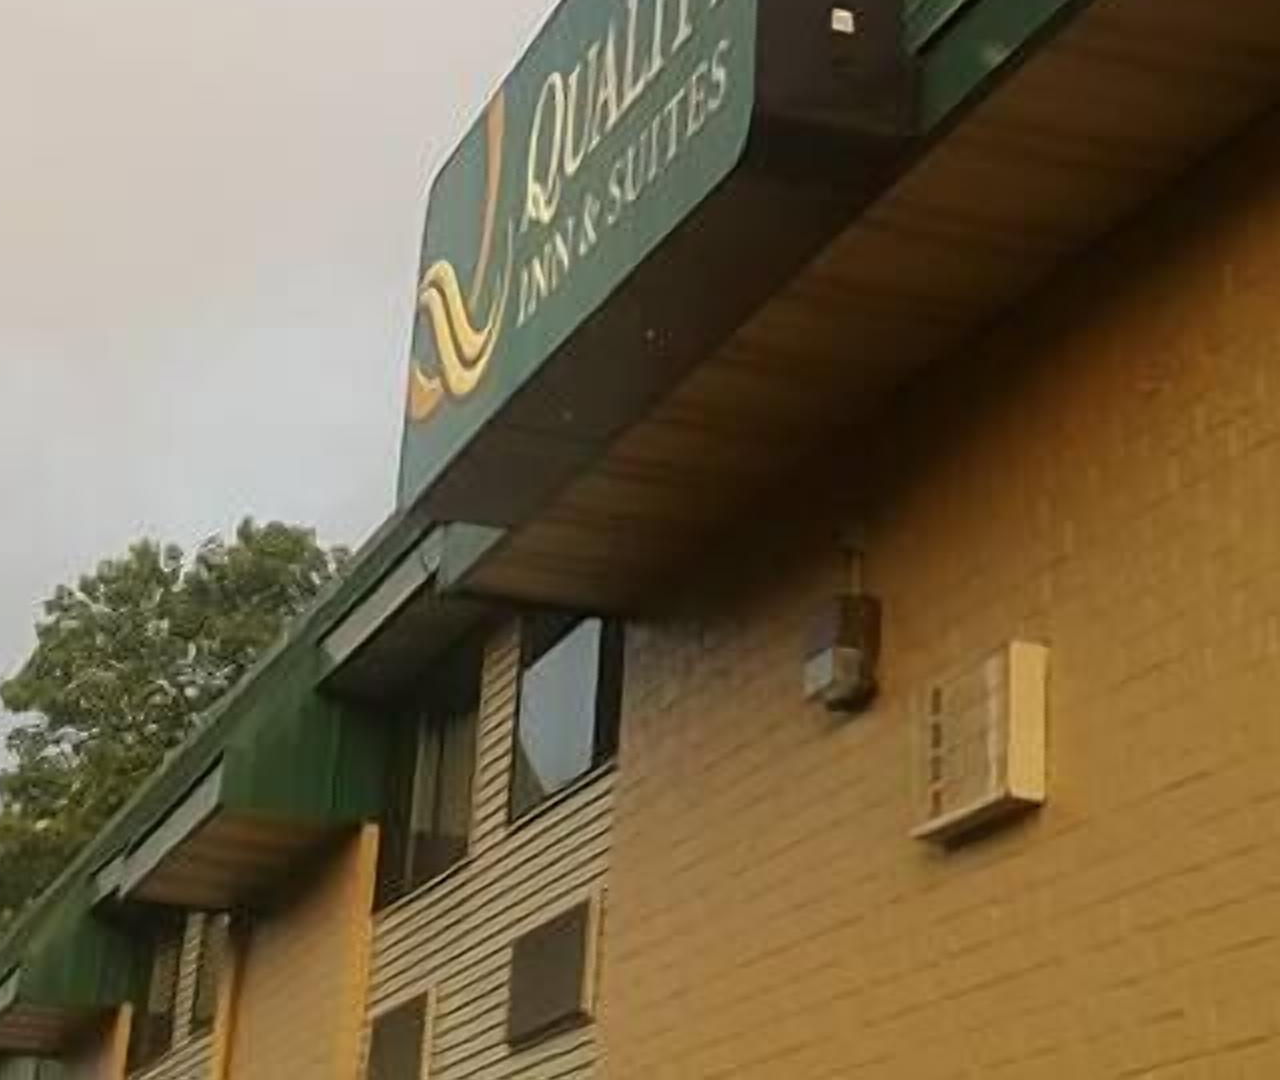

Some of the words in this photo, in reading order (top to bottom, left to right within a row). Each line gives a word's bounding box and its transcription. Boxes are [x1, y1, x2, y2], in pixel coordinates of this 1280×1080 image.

[516, 216, 577, 329] INN
[579, 192, 602, 257] &
[607, 39, 730, 225] SUITES
